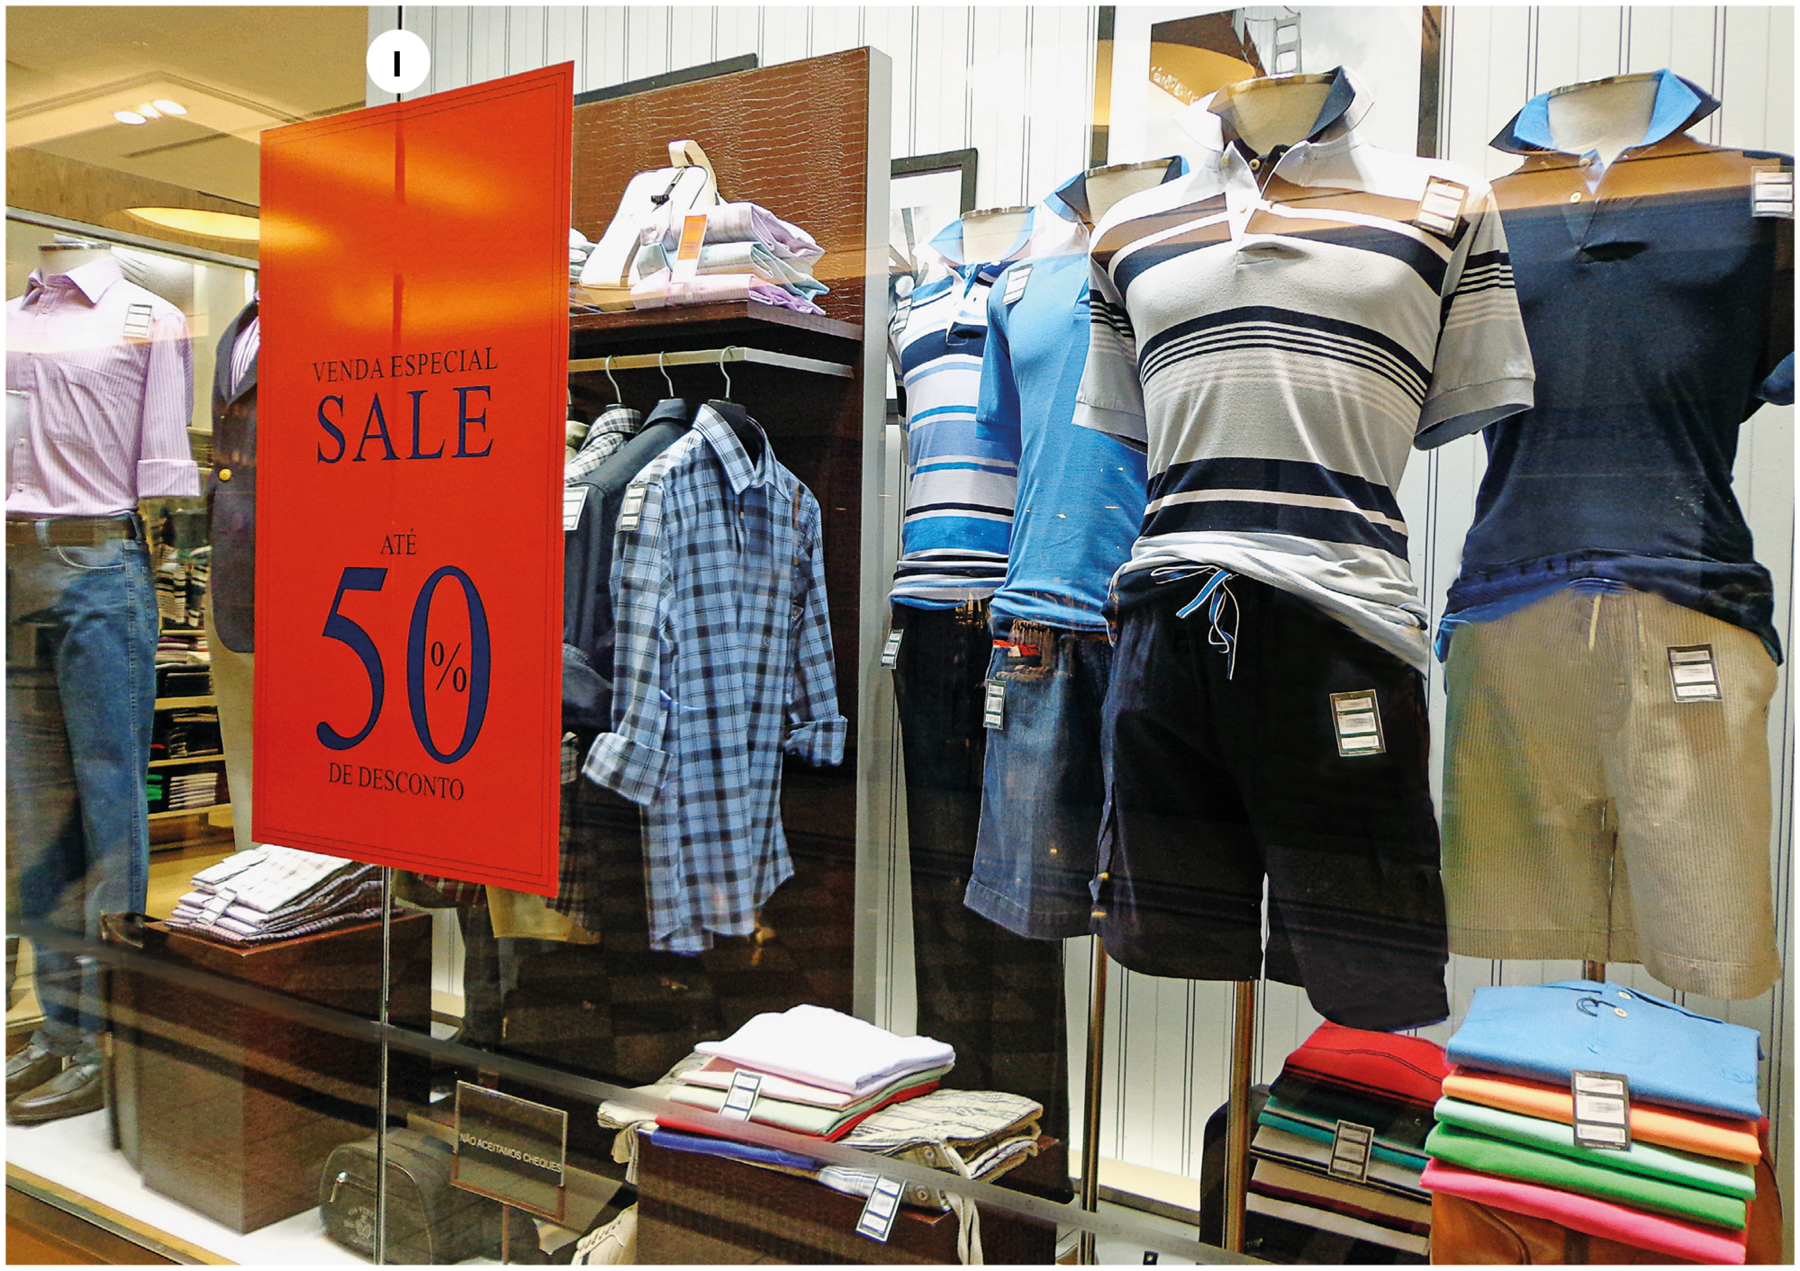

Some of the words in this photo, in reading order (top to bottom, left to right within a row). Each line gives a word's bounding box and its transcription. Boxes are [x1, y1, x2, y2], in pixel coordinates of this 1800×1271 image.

[312, 359, 389, 382] VENDA
[391, 347, 498, 378] ESPECIAL
[317, 386, 493, 465] SALE
[380, 526, 417, 556] ATÉ
[328, 762, 353, 786] DE
[358, 766, 465, 801] DESCONTO
[460, 1133, 476, 1146] NÃO
[477, 1139, 522, 1160] ACEITAMOS
[523, 1153, 563, 1173] CHEQUES
